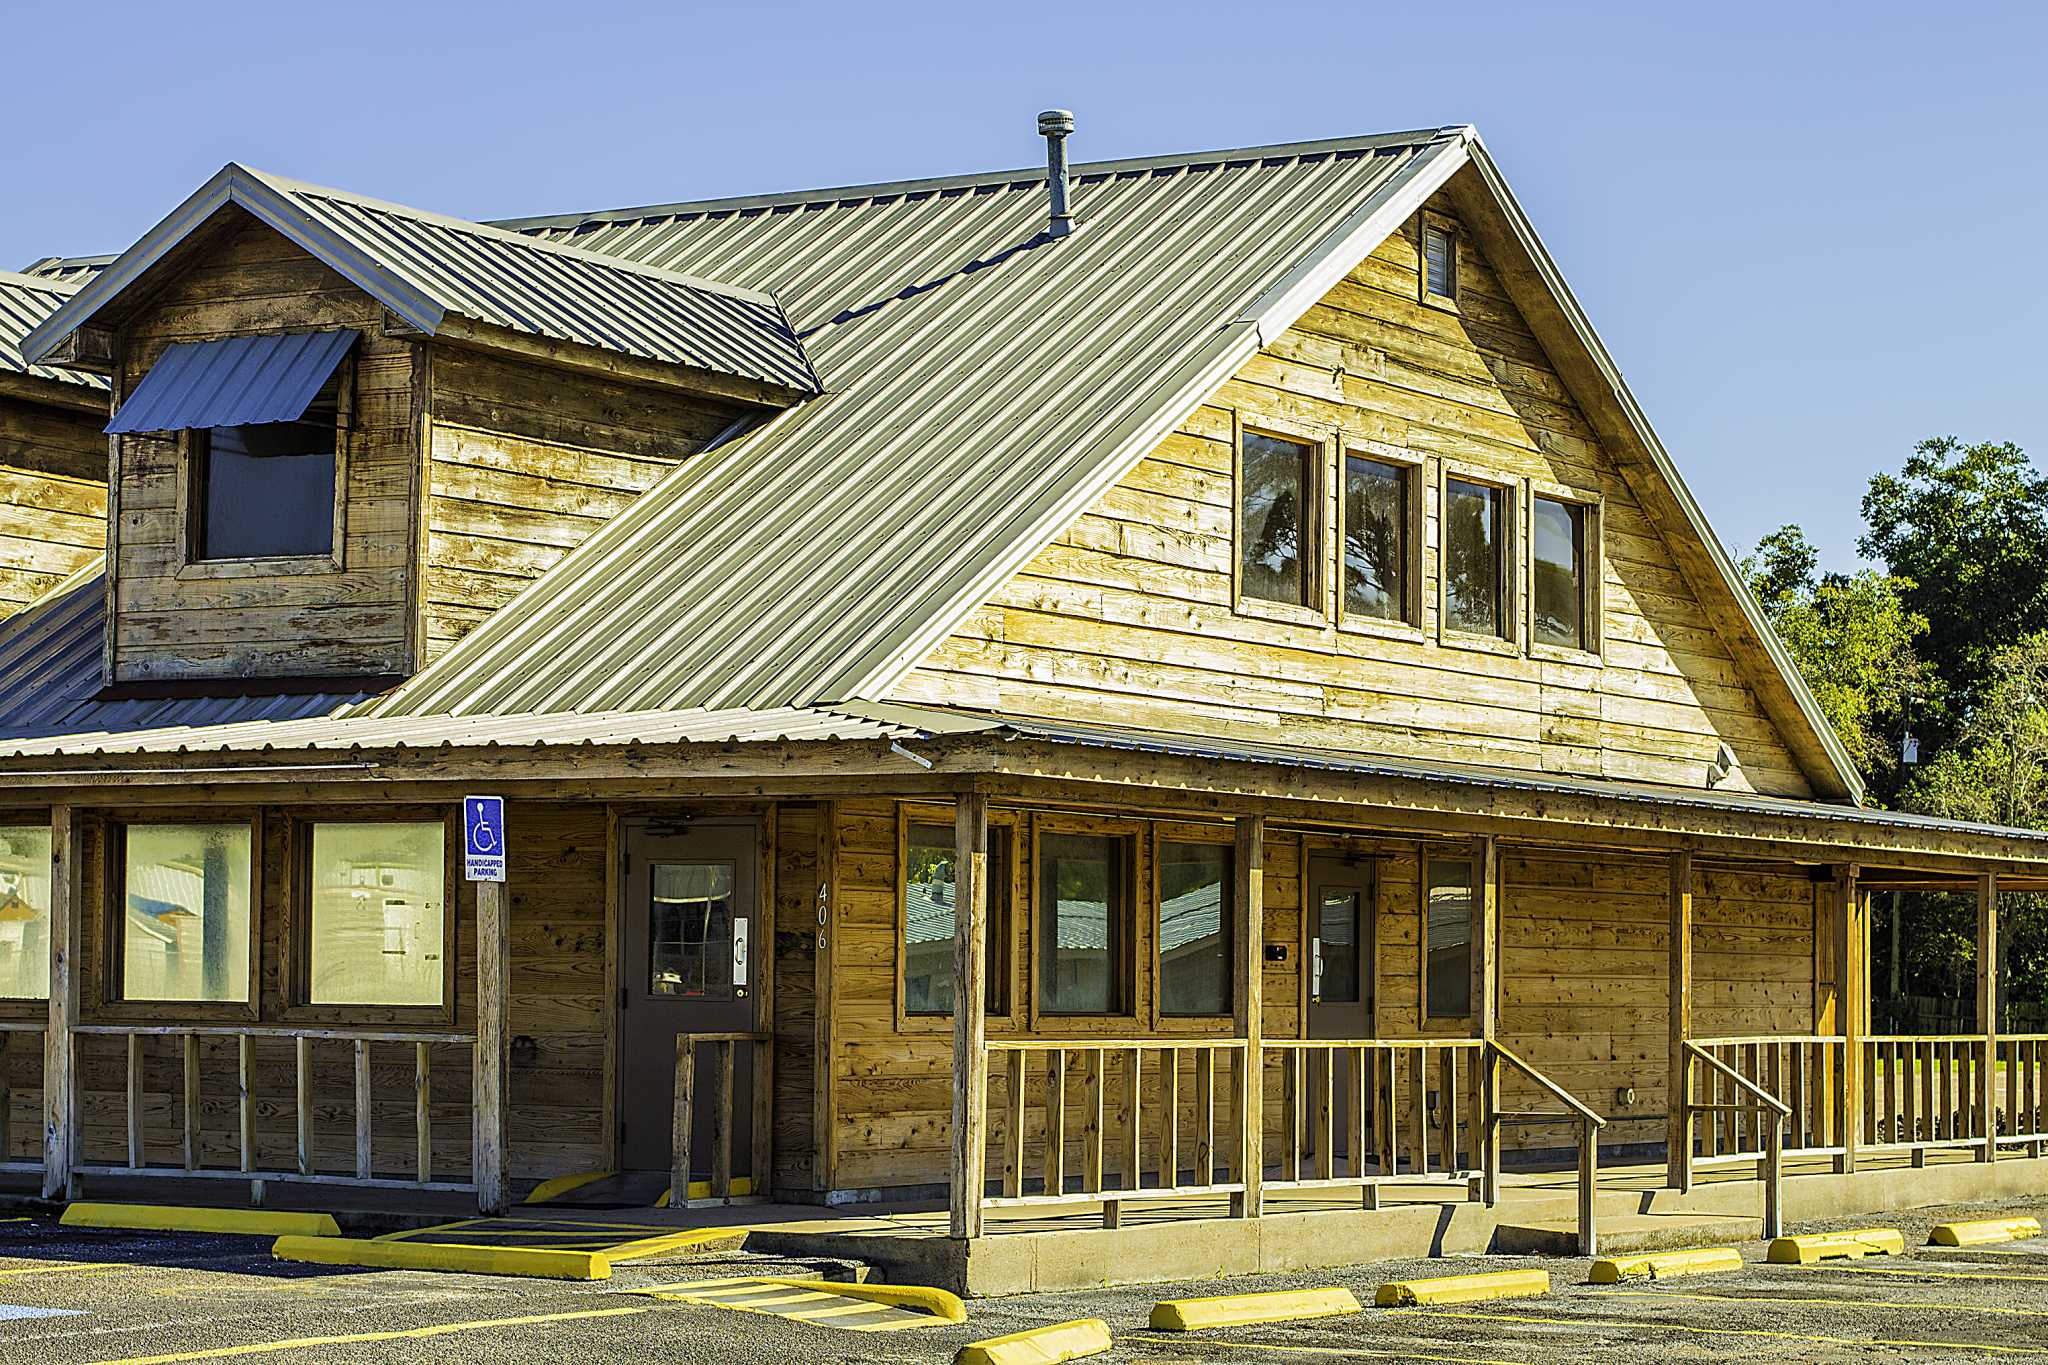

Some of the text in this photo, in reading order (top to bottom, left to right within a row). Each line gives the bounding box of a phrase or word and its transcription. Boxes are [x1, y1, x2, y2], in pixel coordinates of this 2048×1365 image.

[467, 859, 503, 868] HANDICAPPED
[473, 867, 497, 877] PARKING
[818, 882, 828, 949] 406
